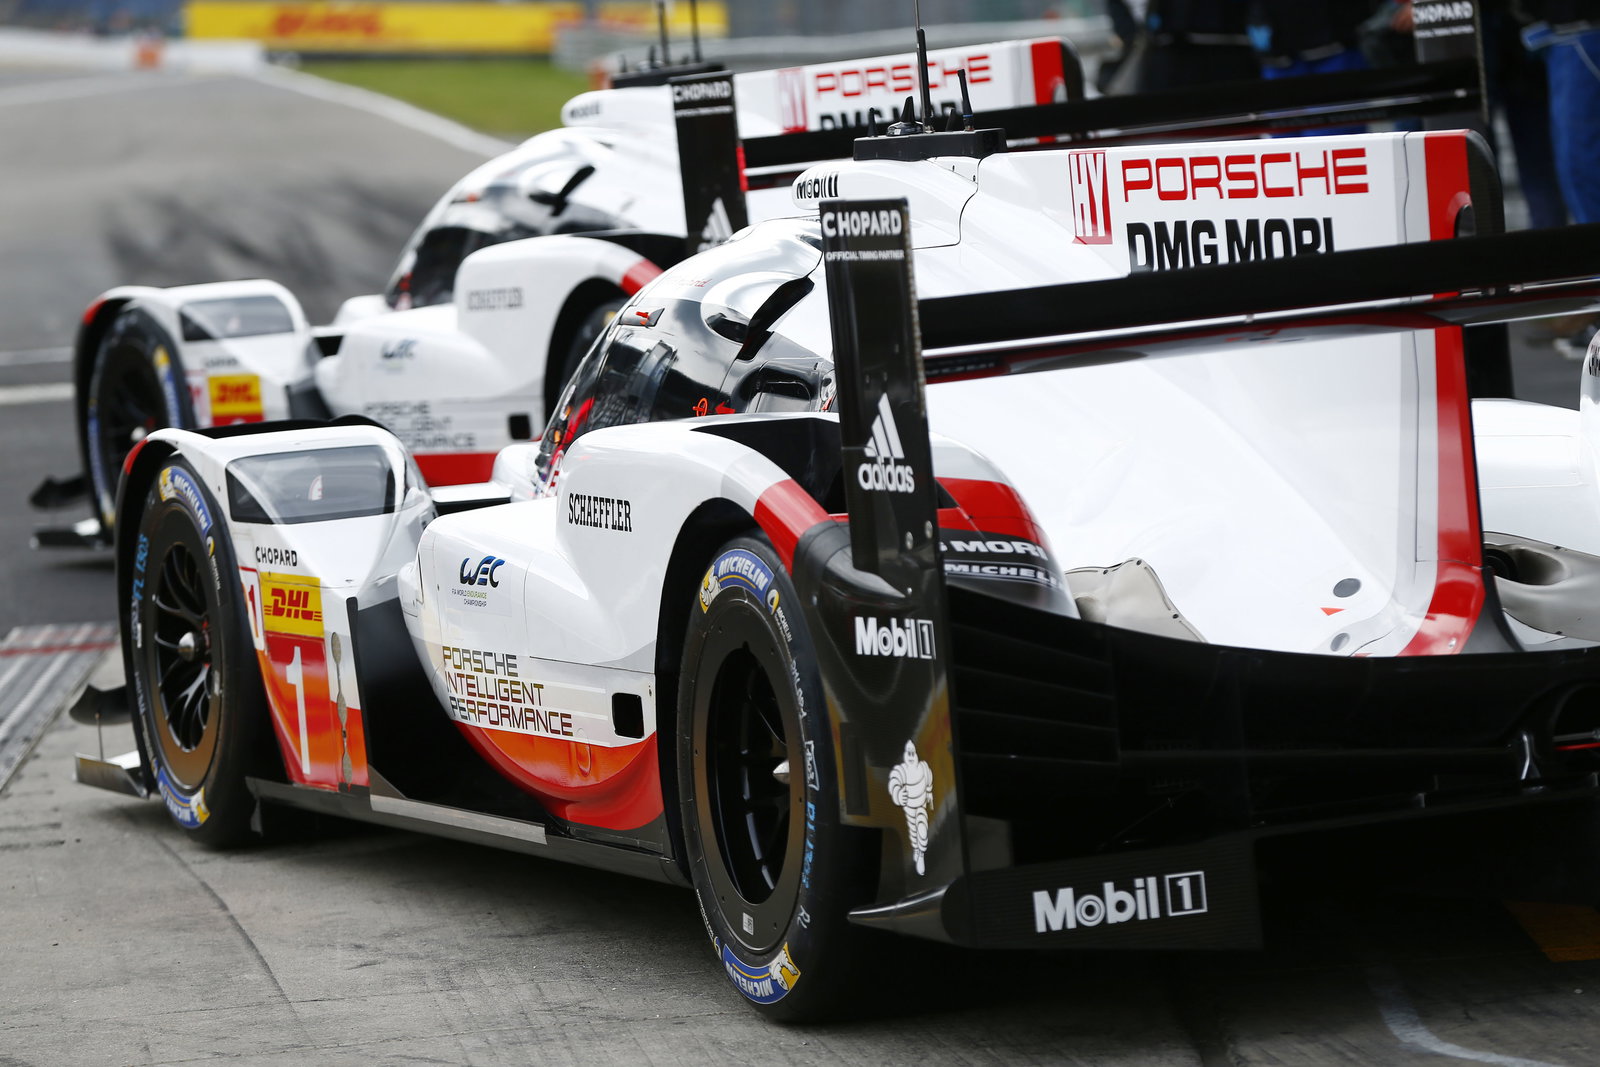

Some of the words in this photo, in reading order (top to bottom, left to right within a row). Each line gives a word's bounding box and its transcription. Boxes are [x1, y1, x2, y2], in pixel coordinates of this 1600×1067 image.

[815, 55, 992, 99] PORSCHE
[1121, 148, 1369, 203] PORSCHE
[822, 209, 902, 237] CHOPARD
[825, 251, 858, 261] OFFICIAL
[878, 249, 905, 260] PARTNER
[1126, 219, 1219, 274] DMG
[1225, 217, 1335, 264] MORI
[857, 456, 915, 493] adidas
[173, 474, 208, 531] MICHELIN
[568, 492, 632, 533] SCHAEFFLER
[255, 546, 298, 567] CHOPARD
[950, 540, 1049, 561] MORI
[460, 555, 506, 588] WEC
[718, 556, 769, 592] MICHELIN
[265, 587, 322, 622] DHL
[777, 606, 793, 643] MICHELIN
[854, 616, 918, 659] Mobil
[442, 645, 519, 678] PORSCHE
[444, 670, 545, 707] INTELLIGENT
[285, 645, 311, 776] 1
[449, 696, 574, 737] PERFORMANCE
[1033, 876, 1161, 934] Mobil
[725, 960, 775, 998] MICHELIN
